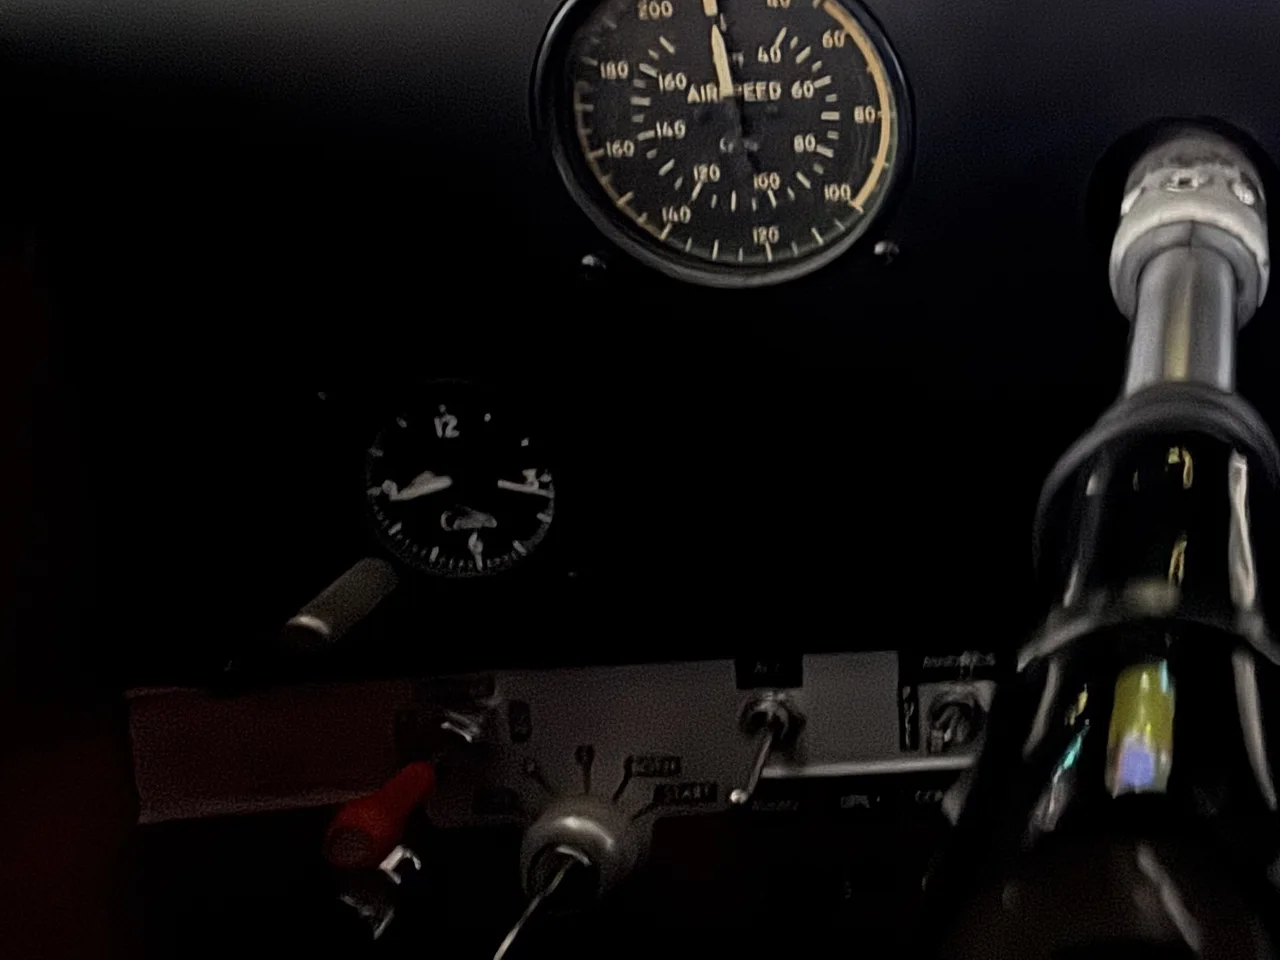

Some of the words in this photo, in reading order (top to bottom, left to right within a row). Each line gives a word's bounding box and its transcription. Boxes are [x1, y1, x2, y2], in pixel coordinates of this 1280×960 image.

[822, 29, 846, 49] 60
[757, 44, 782, 64] 40
[657, 72, 688, 93] 160
[791, 80, 815, 100] 60
[656, 119, 687, 140] 140
[605, 139, 636, 160] 160
[752, 171, 781, 190] 100
[823, 184, 851, 203] 100
[661, 205, 692, 225] 140
[433, 413, 461, 439] 12
